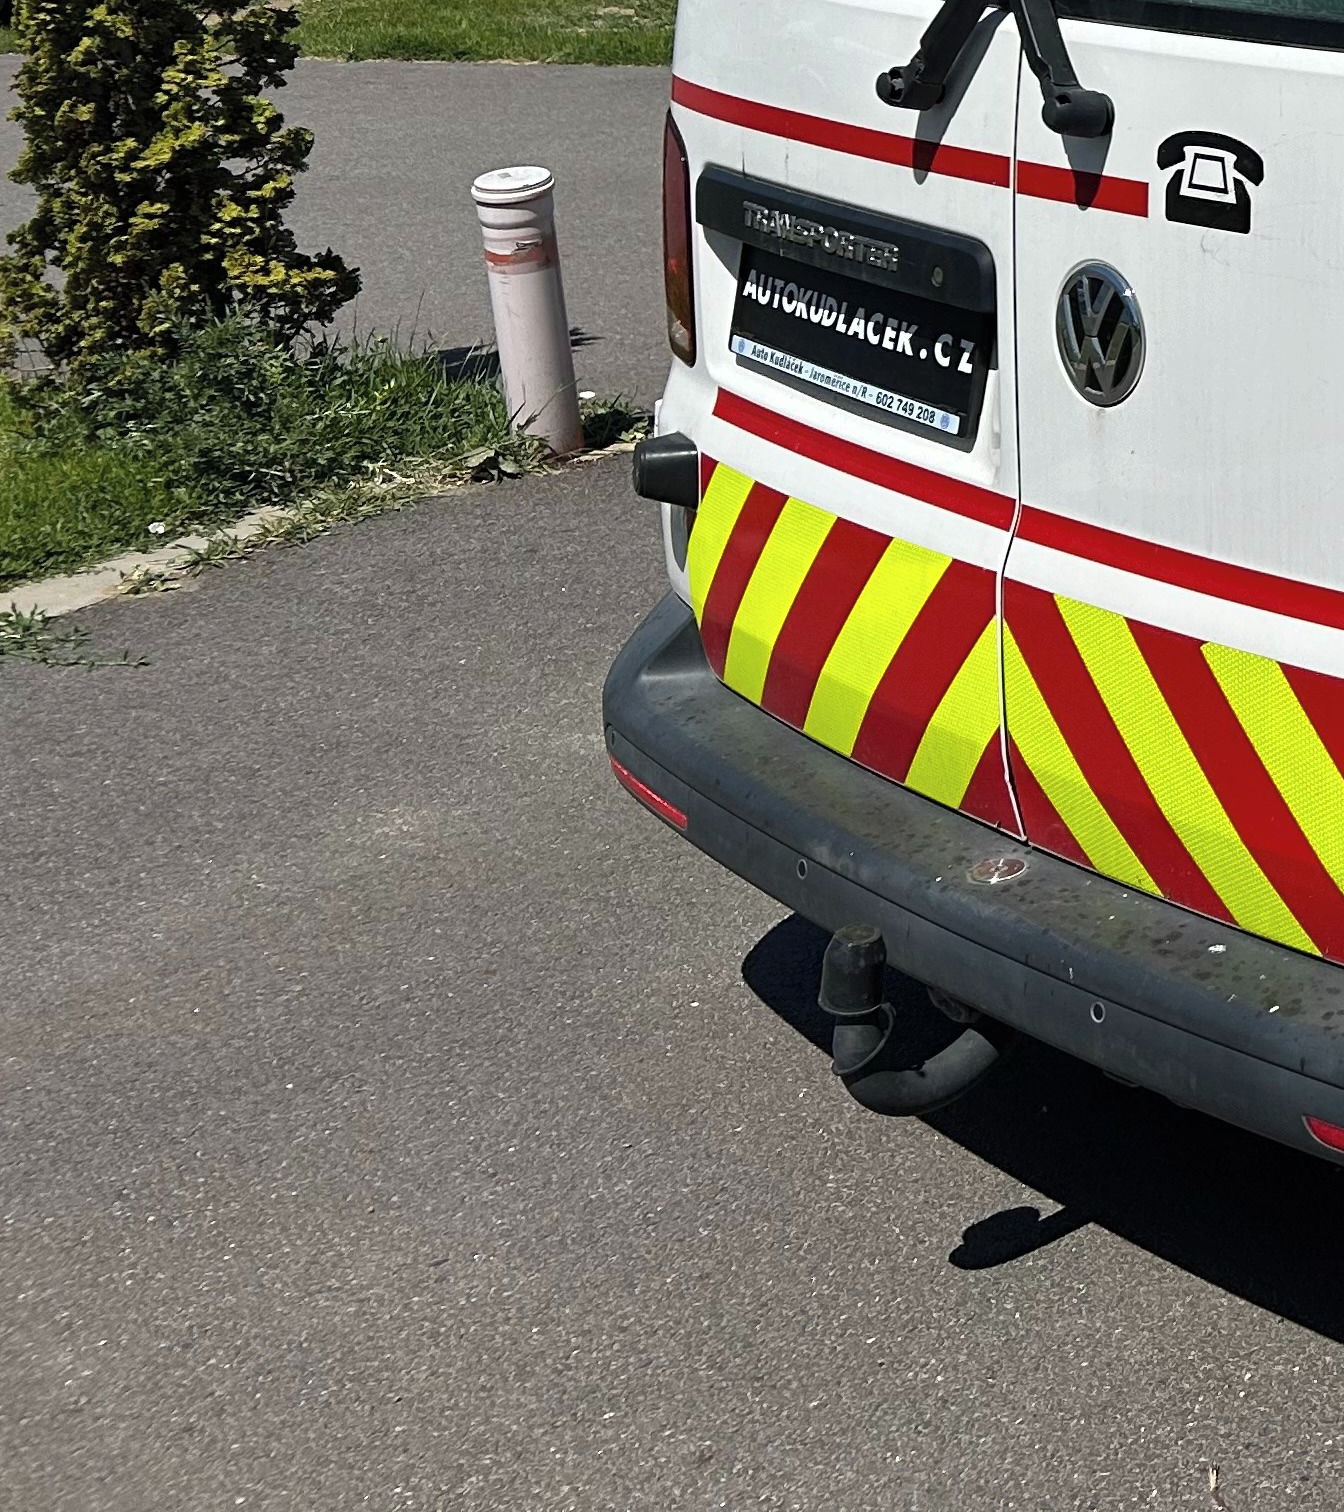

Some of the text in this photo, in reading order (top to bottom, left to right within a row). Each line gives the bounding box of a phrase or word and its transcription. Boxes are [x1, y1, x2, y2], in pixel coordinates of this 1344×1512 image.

[743, 200, 899, 272] TRANSPORTER
[751, 345, 769, 361] Auto
[875, 392, 894, 409] 602
[896, 398, 915, 416] 749
[916, 406, 936, 424] 208
